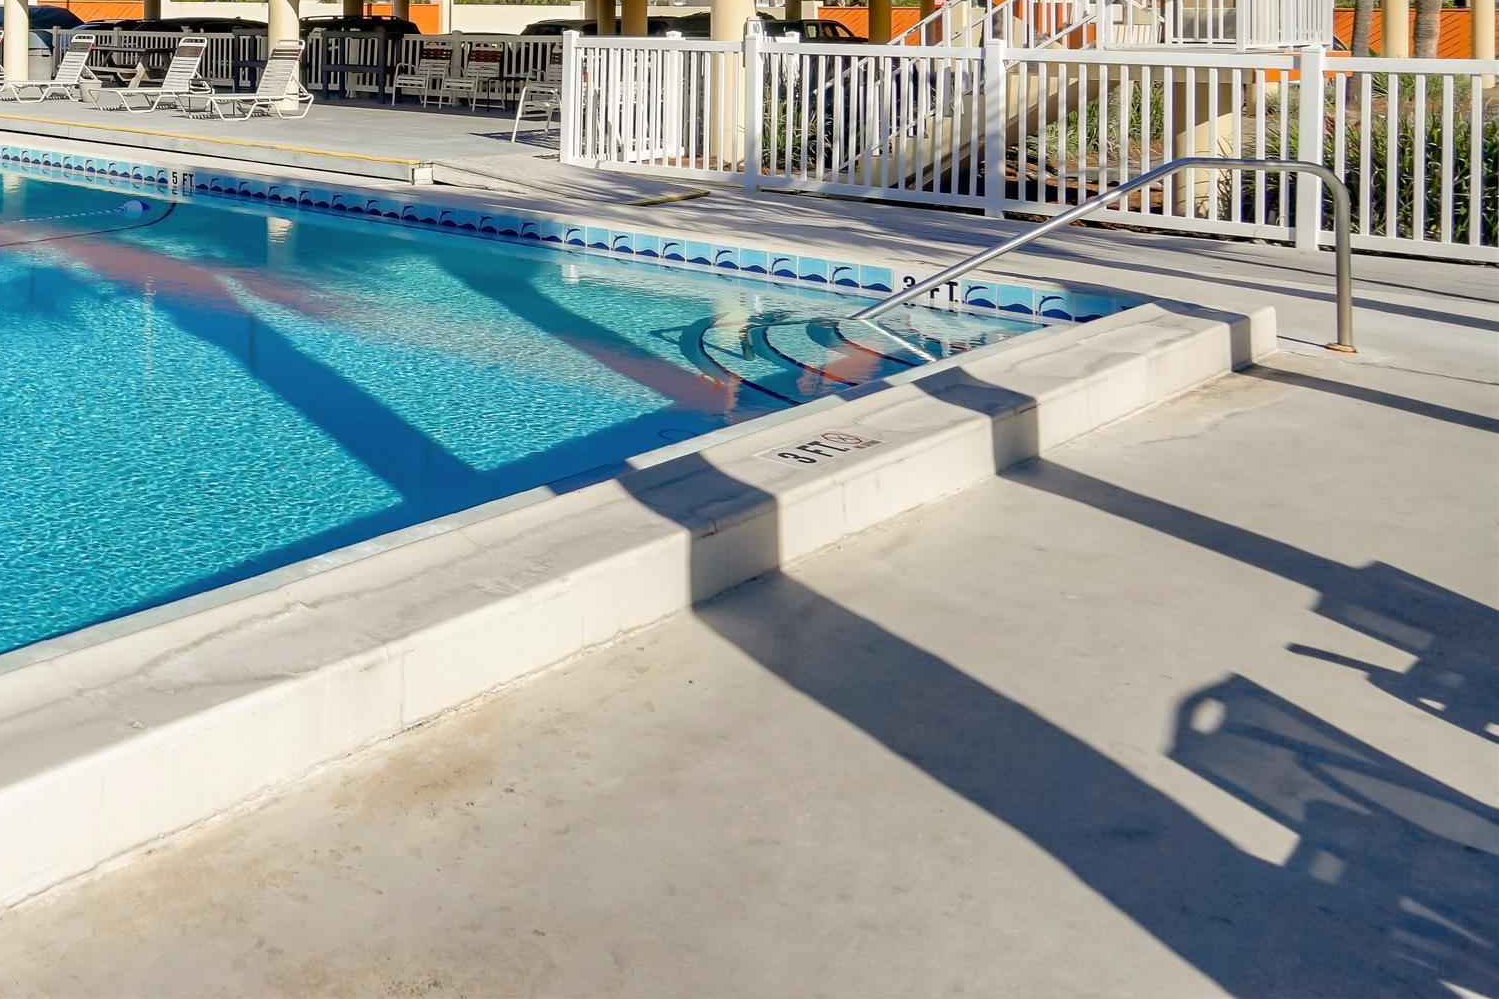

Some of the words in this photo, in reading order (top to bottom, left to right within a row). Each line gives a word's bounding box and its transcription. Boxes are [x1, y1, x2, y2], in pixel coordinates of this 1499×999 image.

[172, 171, 178, 185] 5
[903, 276, 916, 296] 3
[777, 452, 818, 464] 3
